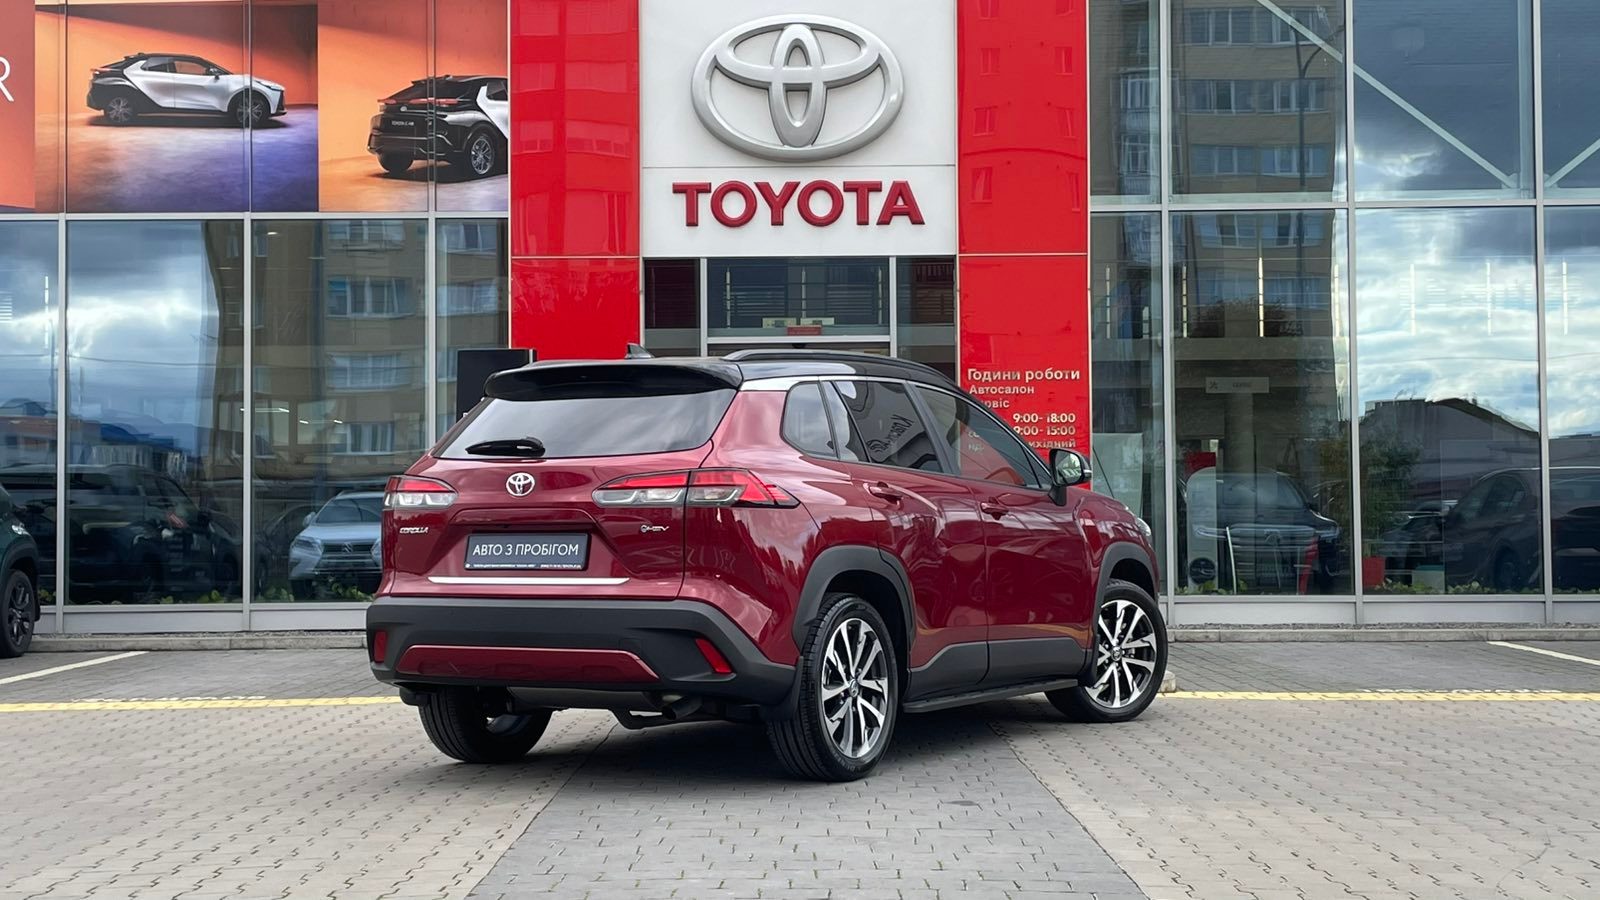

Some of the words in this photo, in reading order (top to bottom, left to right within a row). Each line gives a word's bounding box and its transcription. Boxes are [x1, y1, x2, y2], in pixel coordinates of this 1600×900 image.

[672, 180, 925, 227] TOYOTA
[967, 368, 1020, 381] Години
[1025, 367, 1080, 382] роботи
[969, 385, 1034, 394] Автосалон
[1028, 439, 1076, 449] ихідний
[472, 544, 503, 556] АВТО
[515, 543, 579, 556] ПРОБІГОМ
